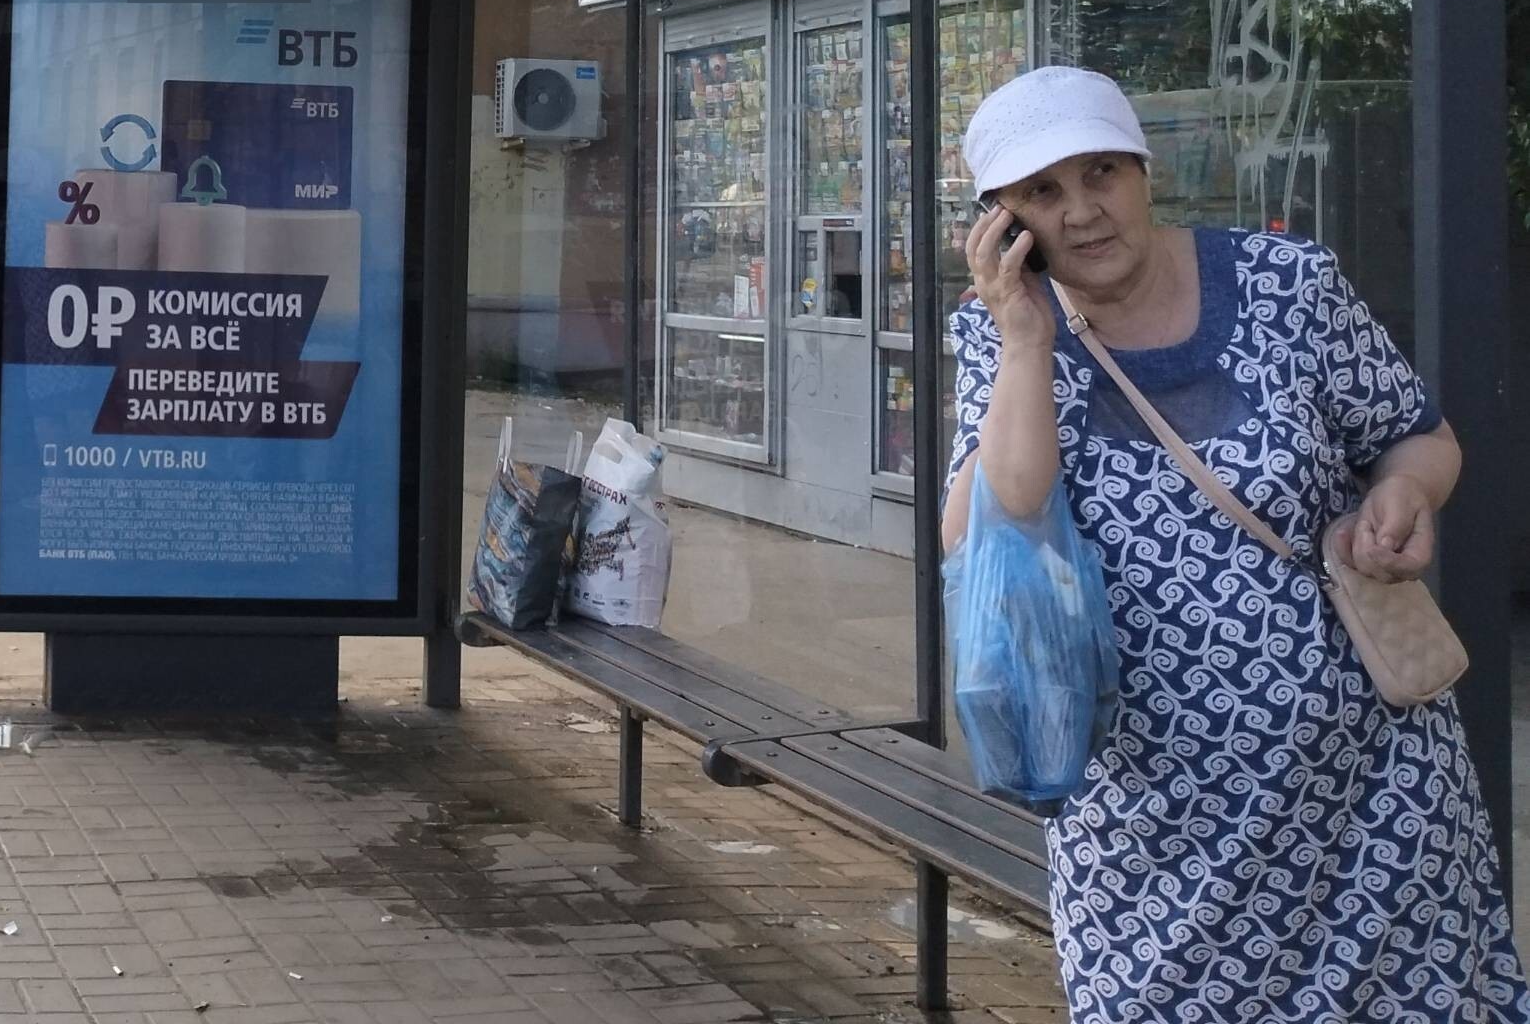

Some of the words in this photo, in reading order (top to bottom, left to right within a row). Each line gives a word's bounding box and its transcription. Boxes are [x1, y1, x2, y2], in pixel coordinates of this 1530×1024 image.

[278, 29, 358, 68] ВТБ
[307, 102, 339, 119] ВТБ
[295, 184, 338, 199] МИР
[147, 289, 302, 318] КОМИССИЯ
[146, 324, 182, 350] ЗА
[190, 320, 241, 351] ВСЁ
[128, 369, 279, 397] ПЕРЕВЕДИТЕ
[127, 399, 253, 423] ЗАРПЛАТУ
[261, 403, 276, 423] В
[283, 402, 327, 425] ВТБ
[64, 446, 116, 468] 1000
[139, 449, 207, 469] VTB.RU
